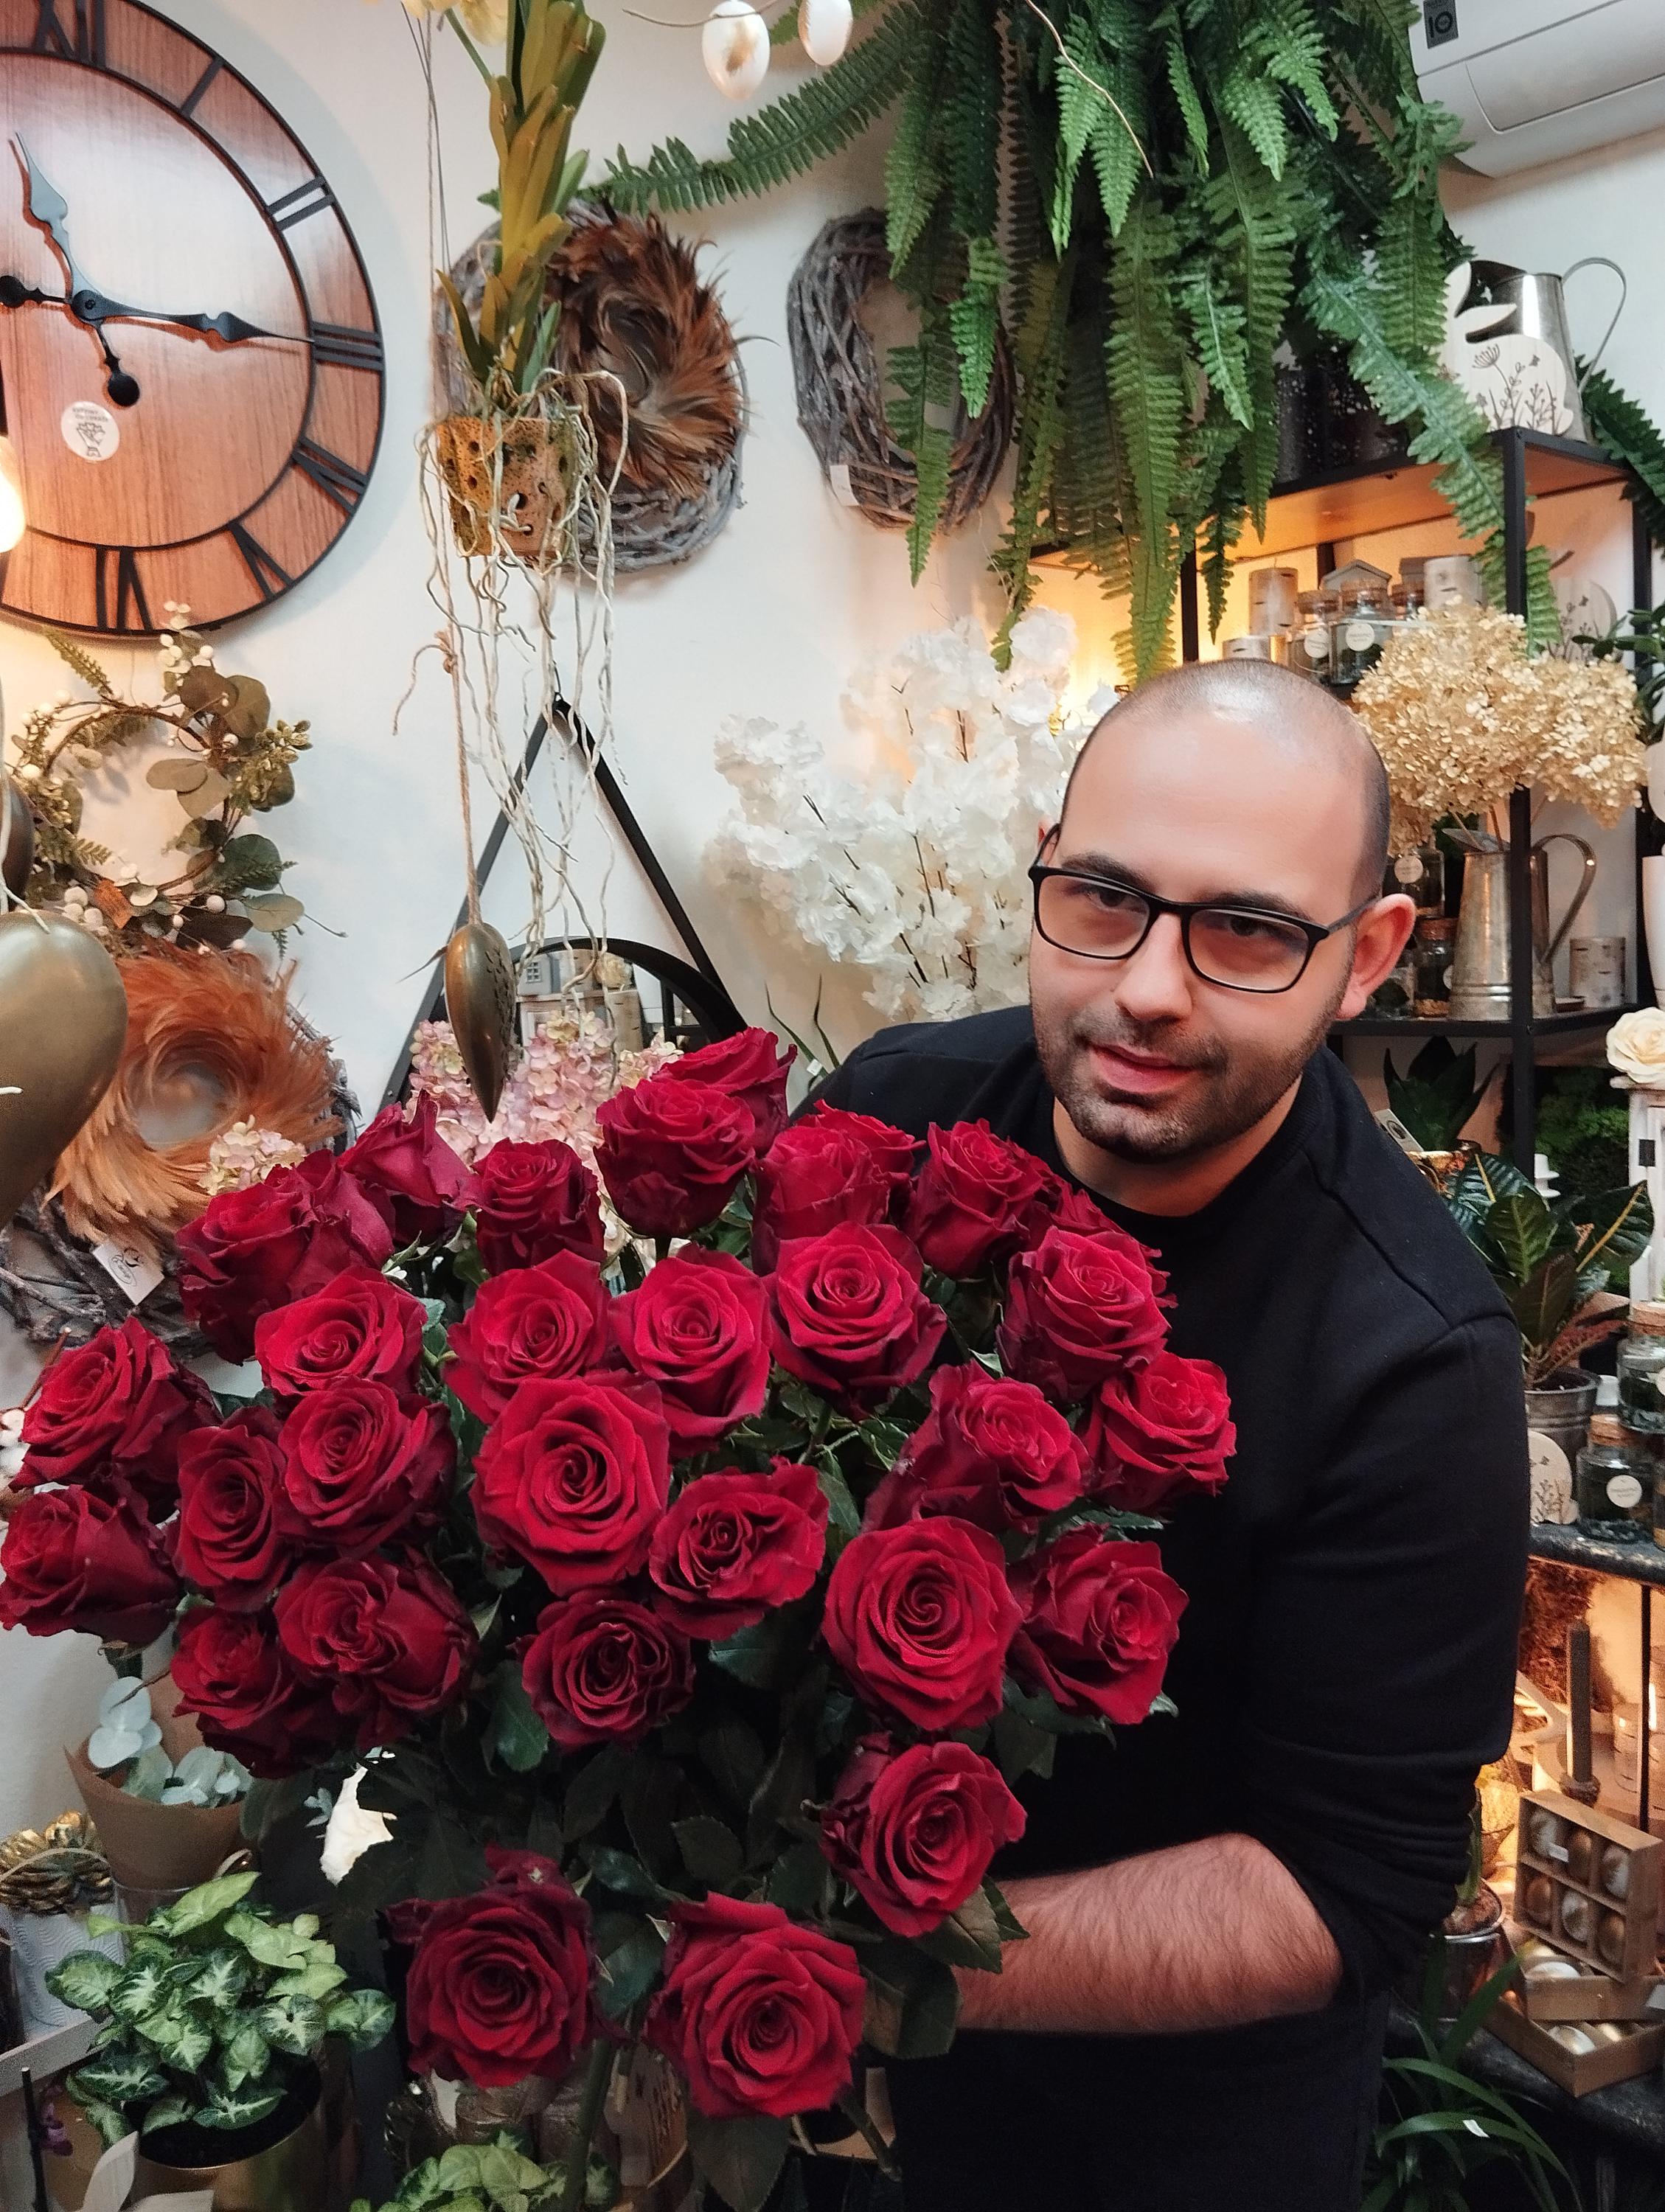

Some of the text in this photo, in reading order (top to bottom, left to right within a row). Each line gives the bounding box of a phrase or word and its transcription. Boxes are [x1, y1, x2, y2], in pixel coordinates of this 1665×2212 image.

[266, 175, 336, 232] II
[312, 321, 383, 371] III
[96, 546, 153, 631] VI
